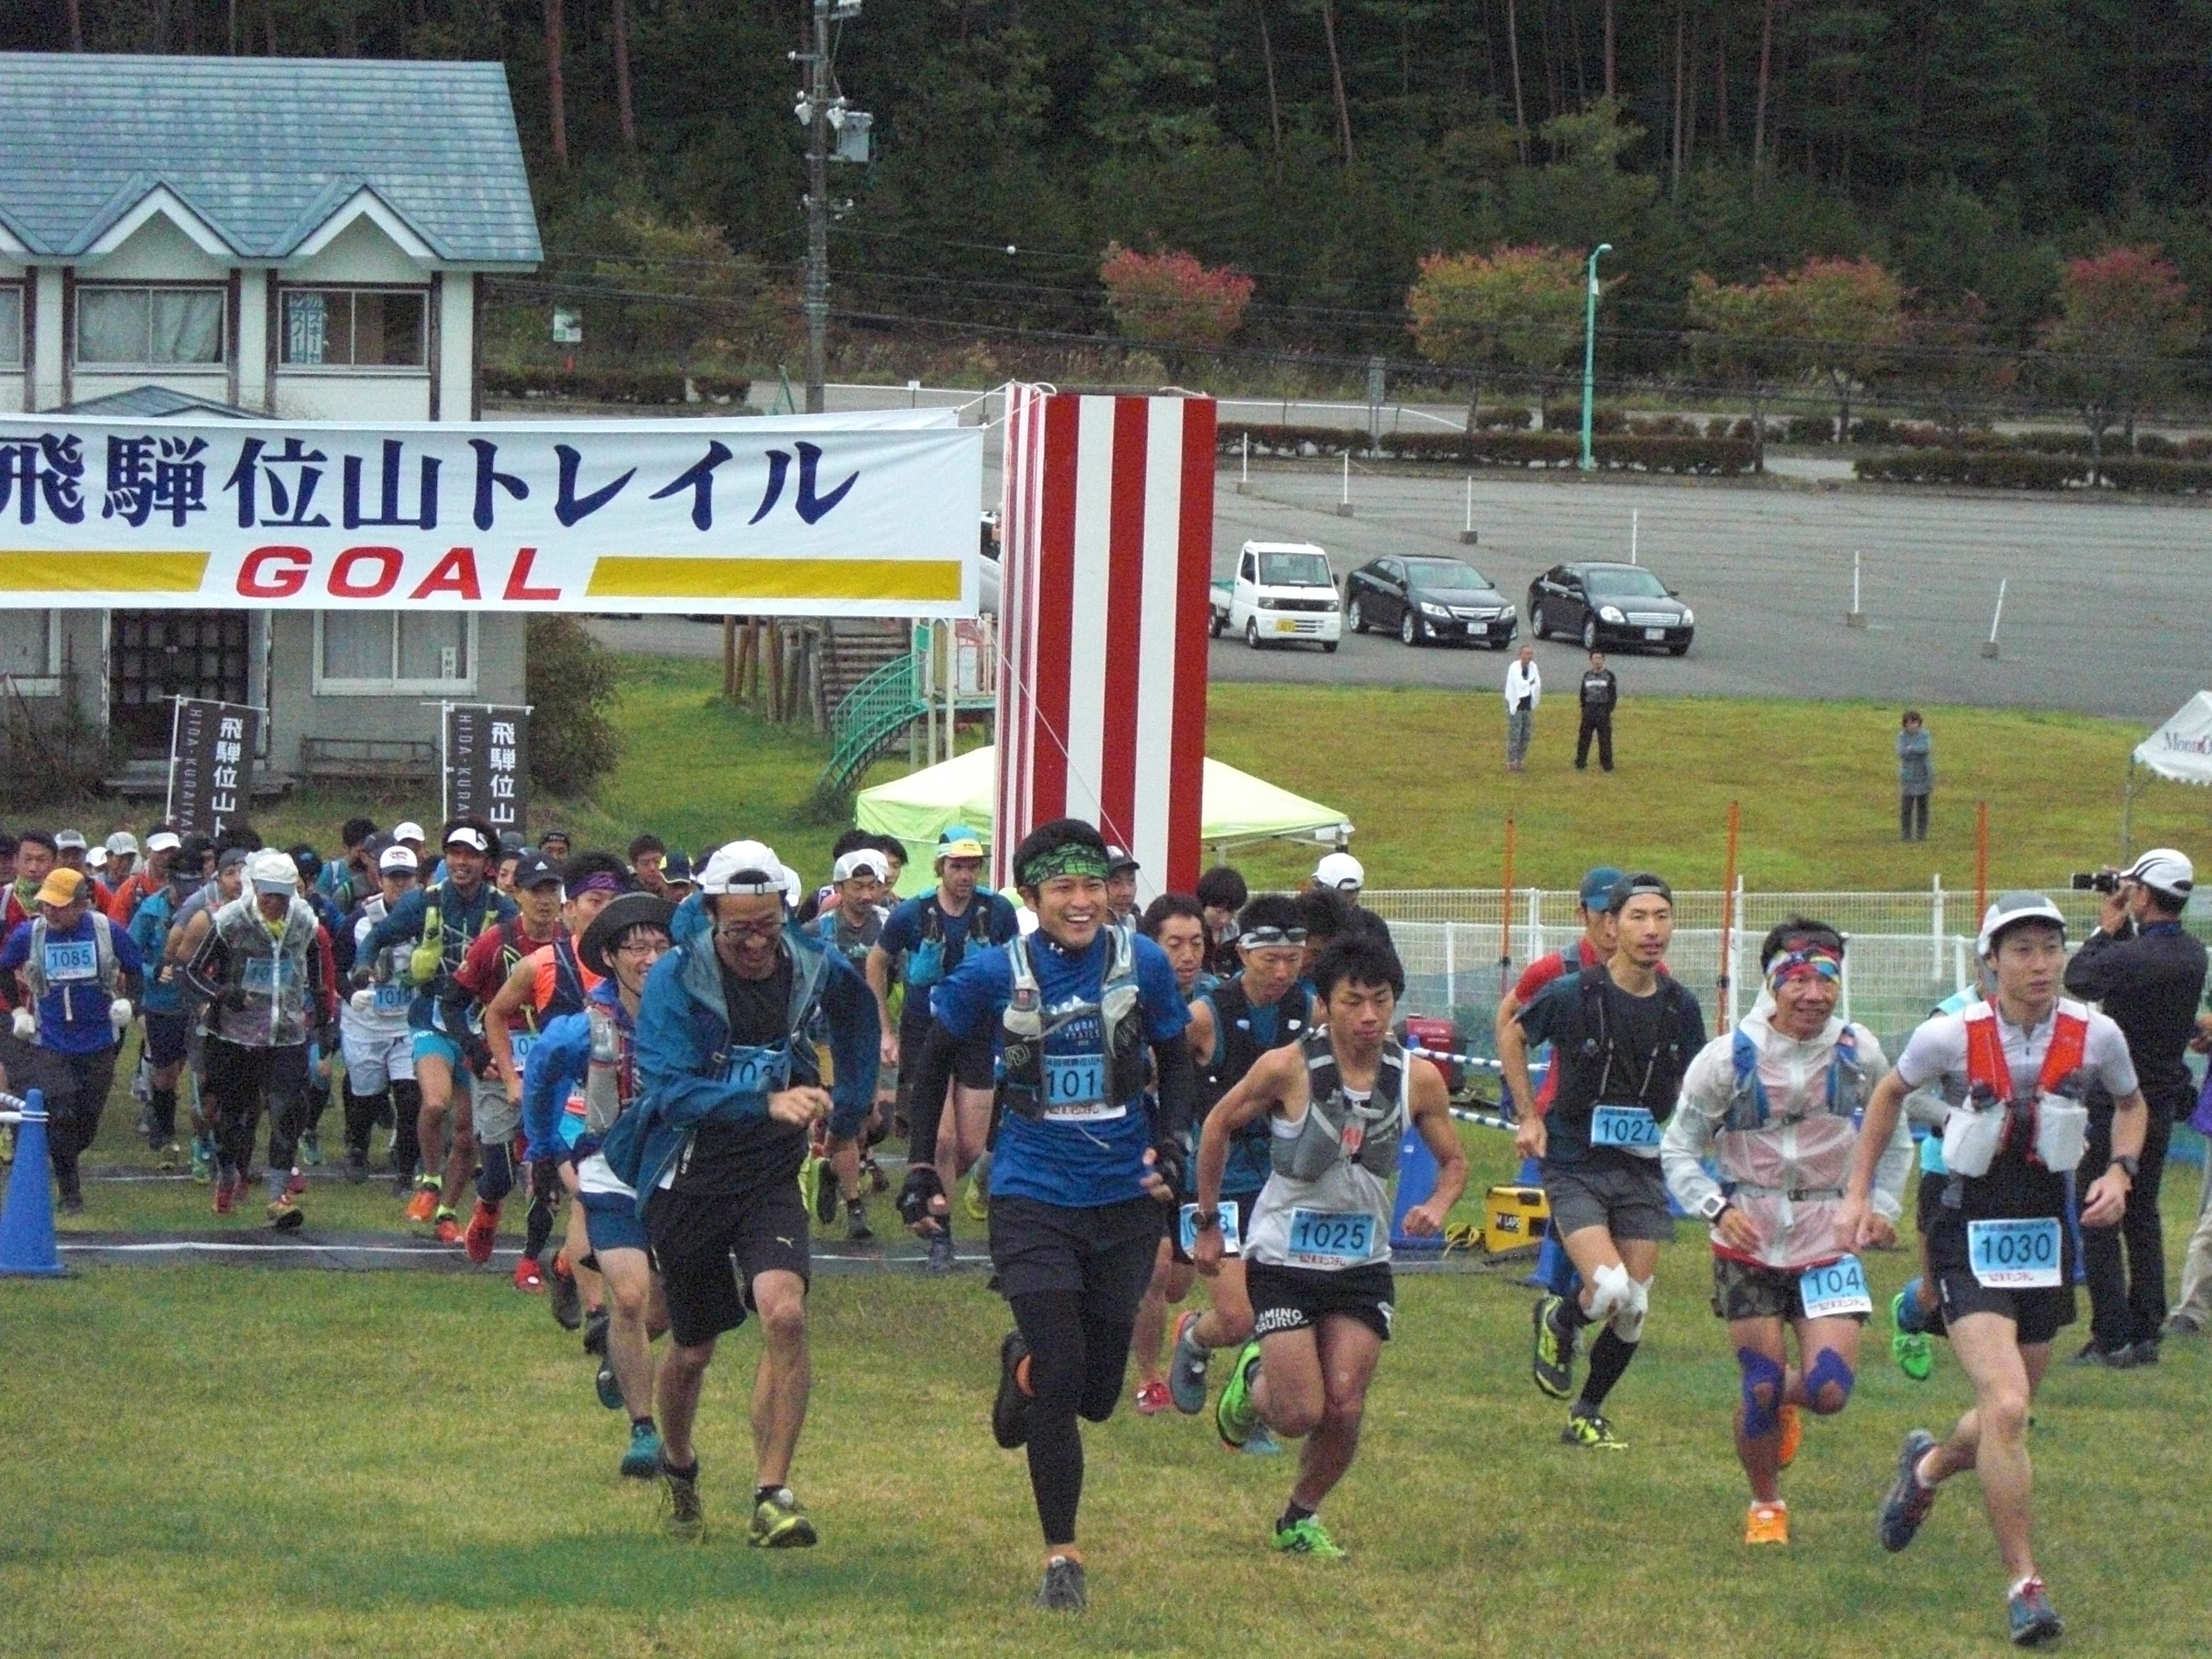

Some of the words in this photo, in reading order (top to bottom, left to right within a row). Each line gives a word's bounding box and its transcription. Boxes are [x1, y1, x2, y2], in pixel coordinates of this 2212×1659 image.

[0, 432, 860, 531] 飛騨位山トレイル
[235, 546, 562, 600] GOAL
[211, 717, 244, 838] 飛騨位山ト
[52, 949, 91, 966] 1085
[1047, 1070, 1105, 1097] 101
[1602, 1118, 1656, 1142] 1027
[1300, 1222, 1365, 1249] 1025
[1982, 1233, 2050, 1264] 1030
[1810, 1266, 1866, 1295] 104
[1258, 1307, 1303, 1323] AMINO
